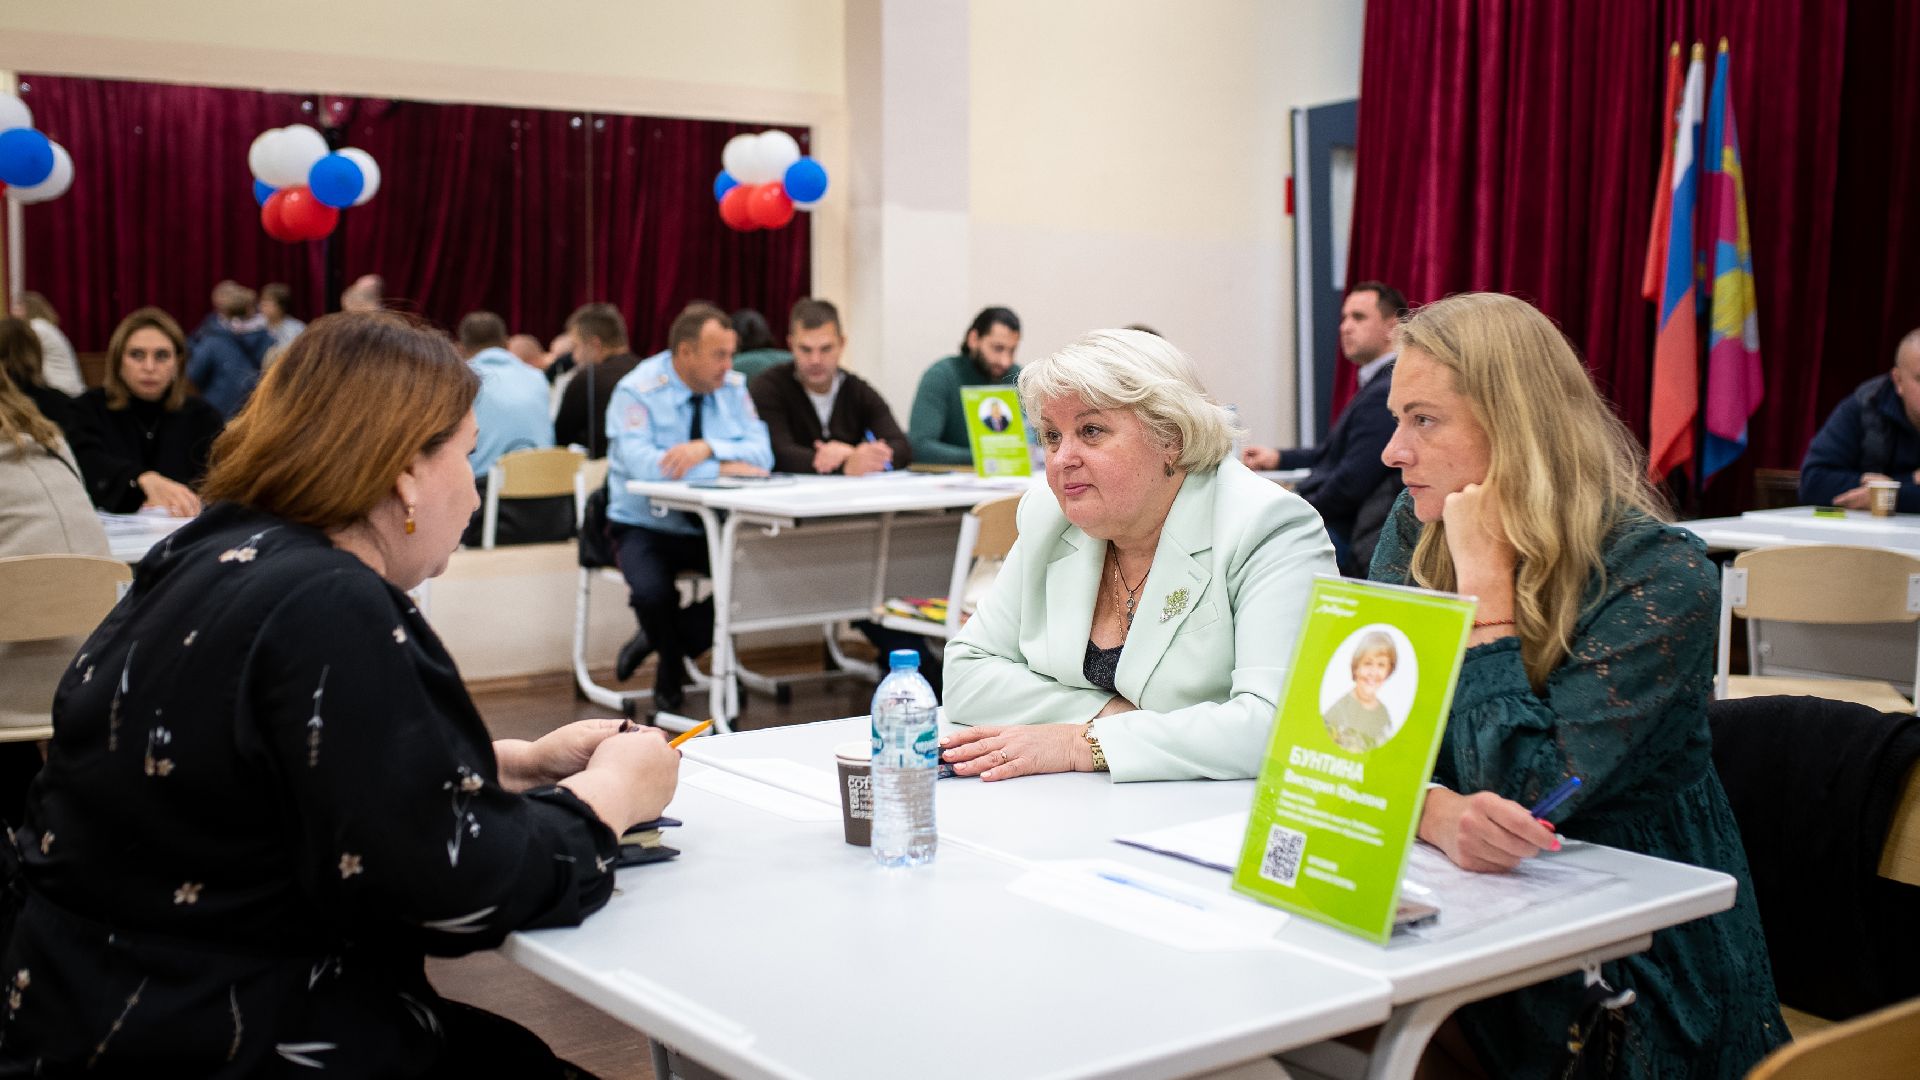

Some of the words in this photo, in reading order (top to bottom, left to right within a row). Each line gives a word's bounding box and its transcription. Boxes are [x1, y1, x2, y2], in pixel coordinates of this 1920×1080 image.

[848, 775, 872, 789] cof
[1289, 745, 1364, 783] БУНТИНА
[1284, 768, 1336, 794] Виктория
[1336, 783, 1387, 811] Юрьевна
